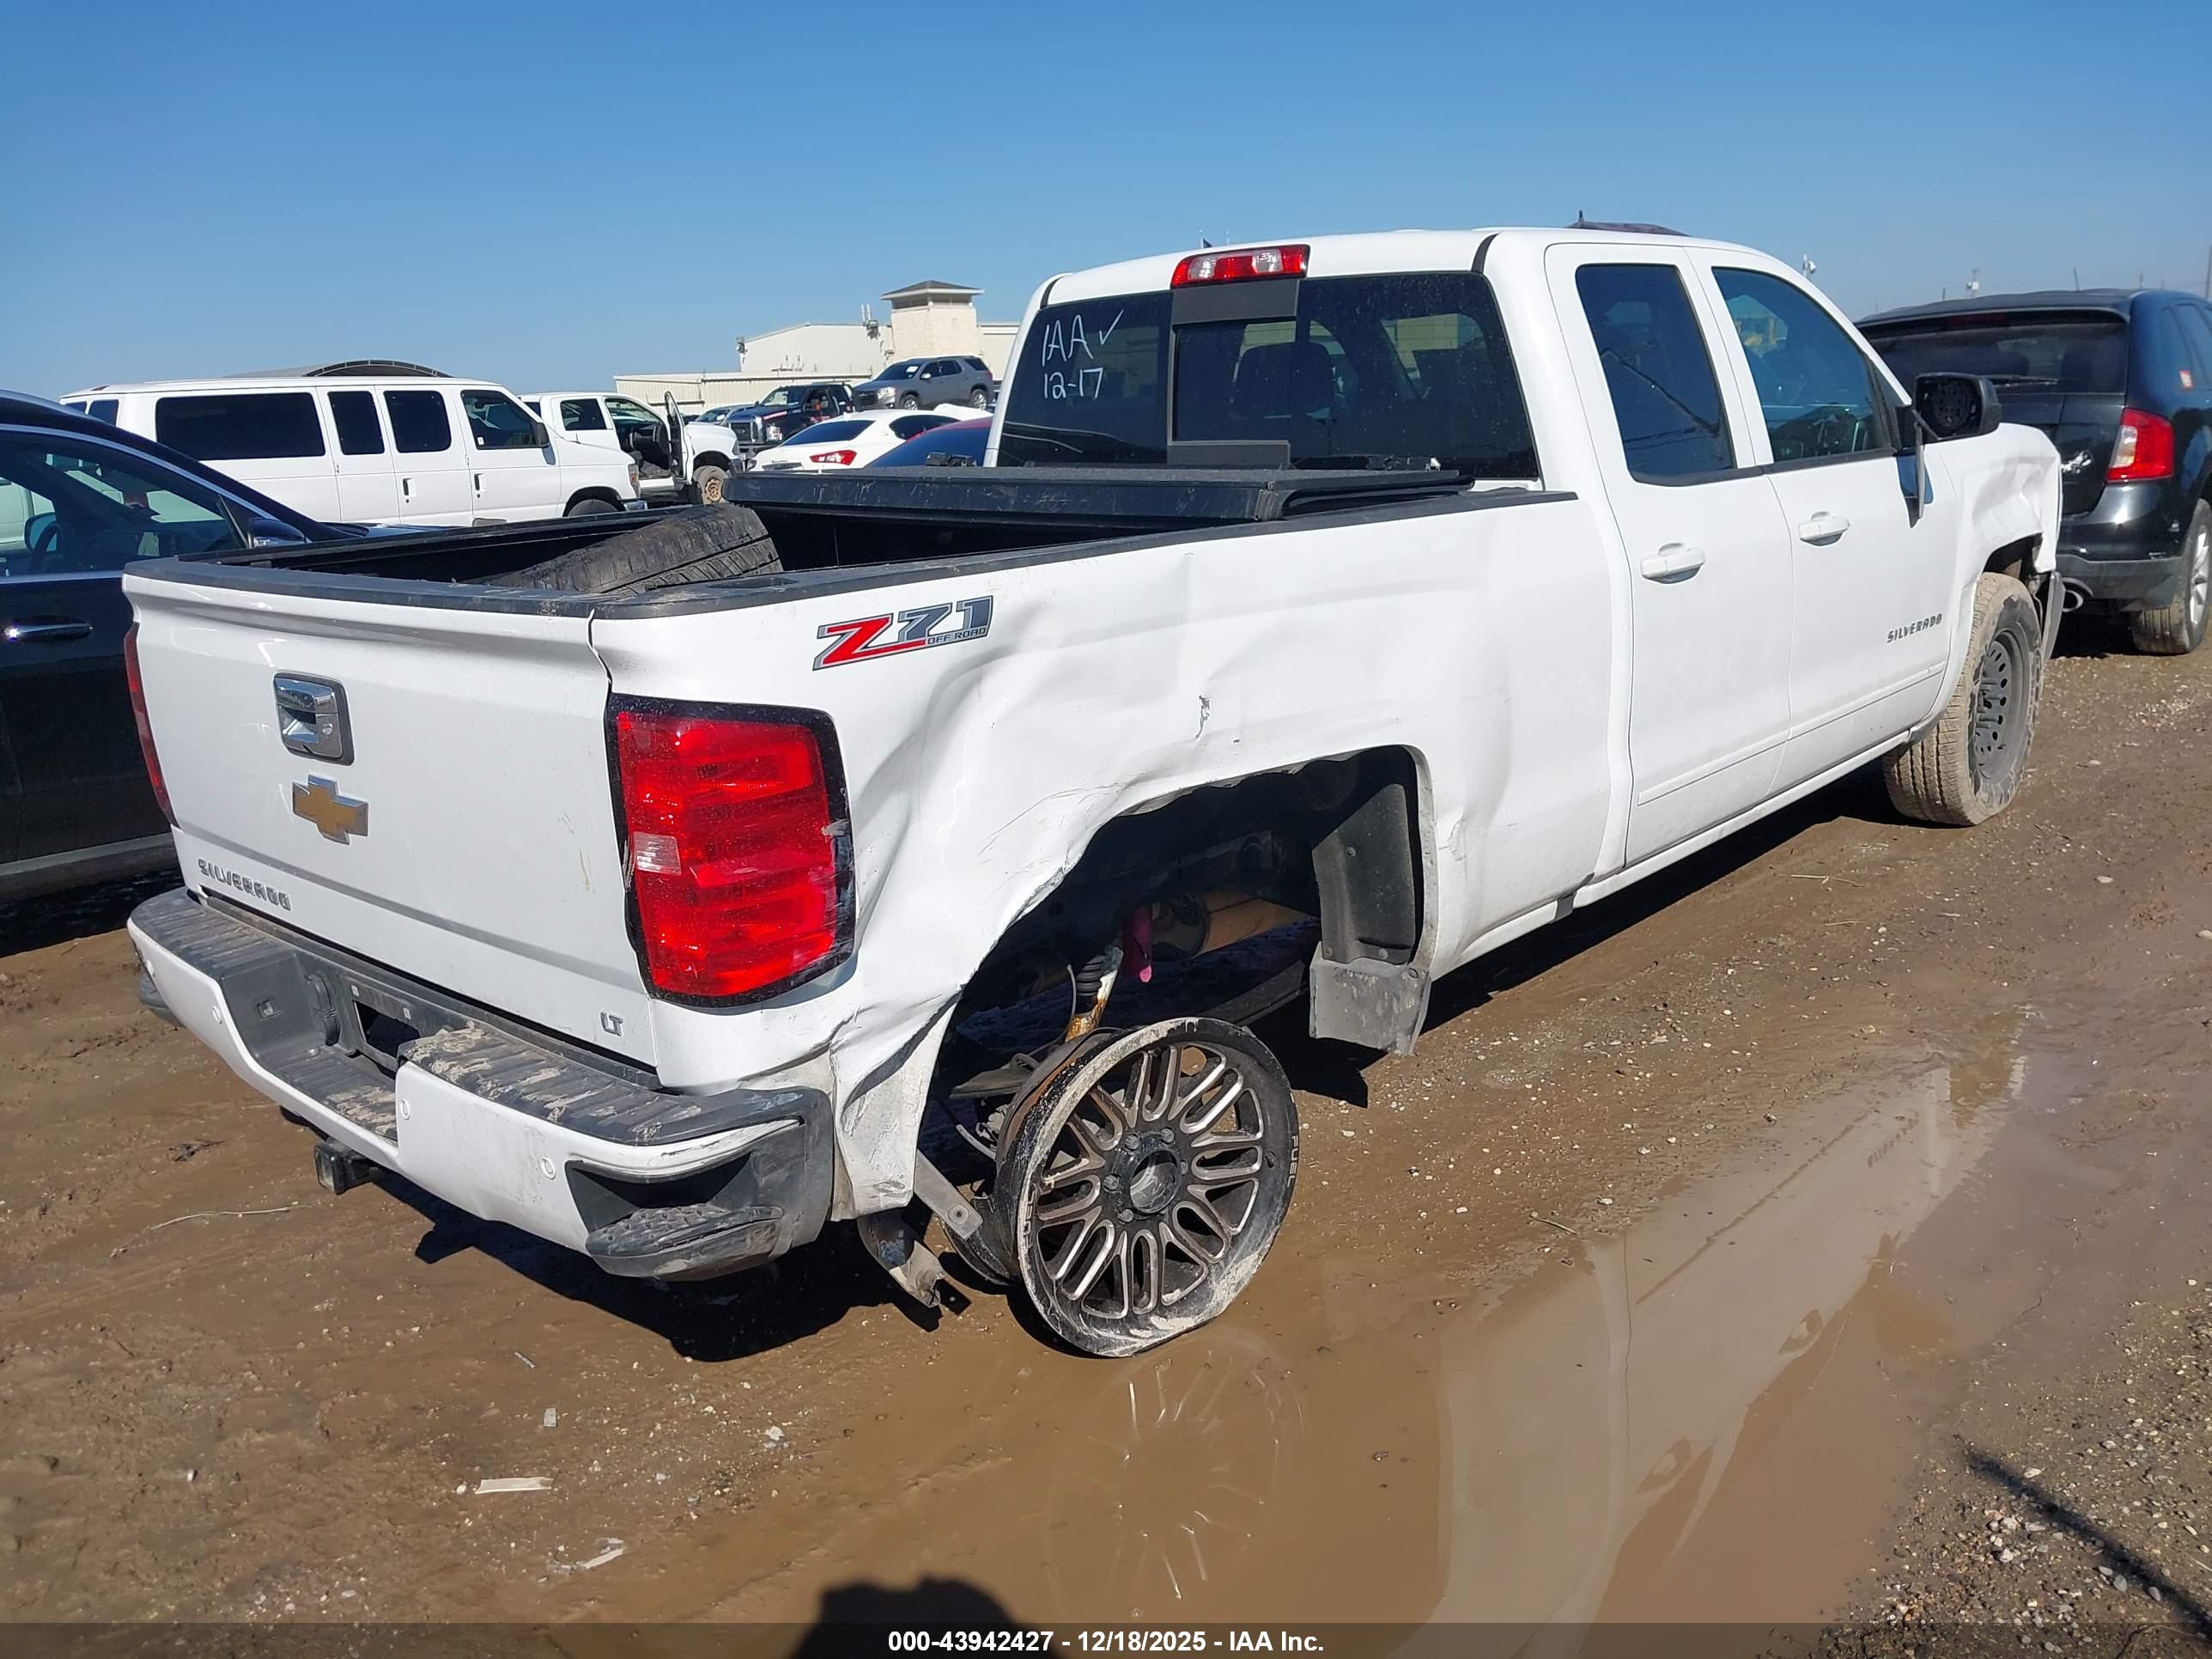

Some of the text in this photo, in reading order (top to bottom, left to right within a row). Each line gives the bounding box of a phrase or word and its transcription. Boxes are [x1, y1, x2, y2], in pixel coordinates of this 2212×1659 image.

[1042, 314, 1094, 368] IAA
[1044, 367, 1103, 399] 12-17
[812, 595, 994, 672] Z71
[927, 627, 987, 645] OFF ROAD
[1886, 612, 1942, 643] SILVERADO
[198, 858, 291, 911] SILVERADO
[600, 1012, 623, 1037] LT
[1286, 1135, 1298, 1188] FUEL
